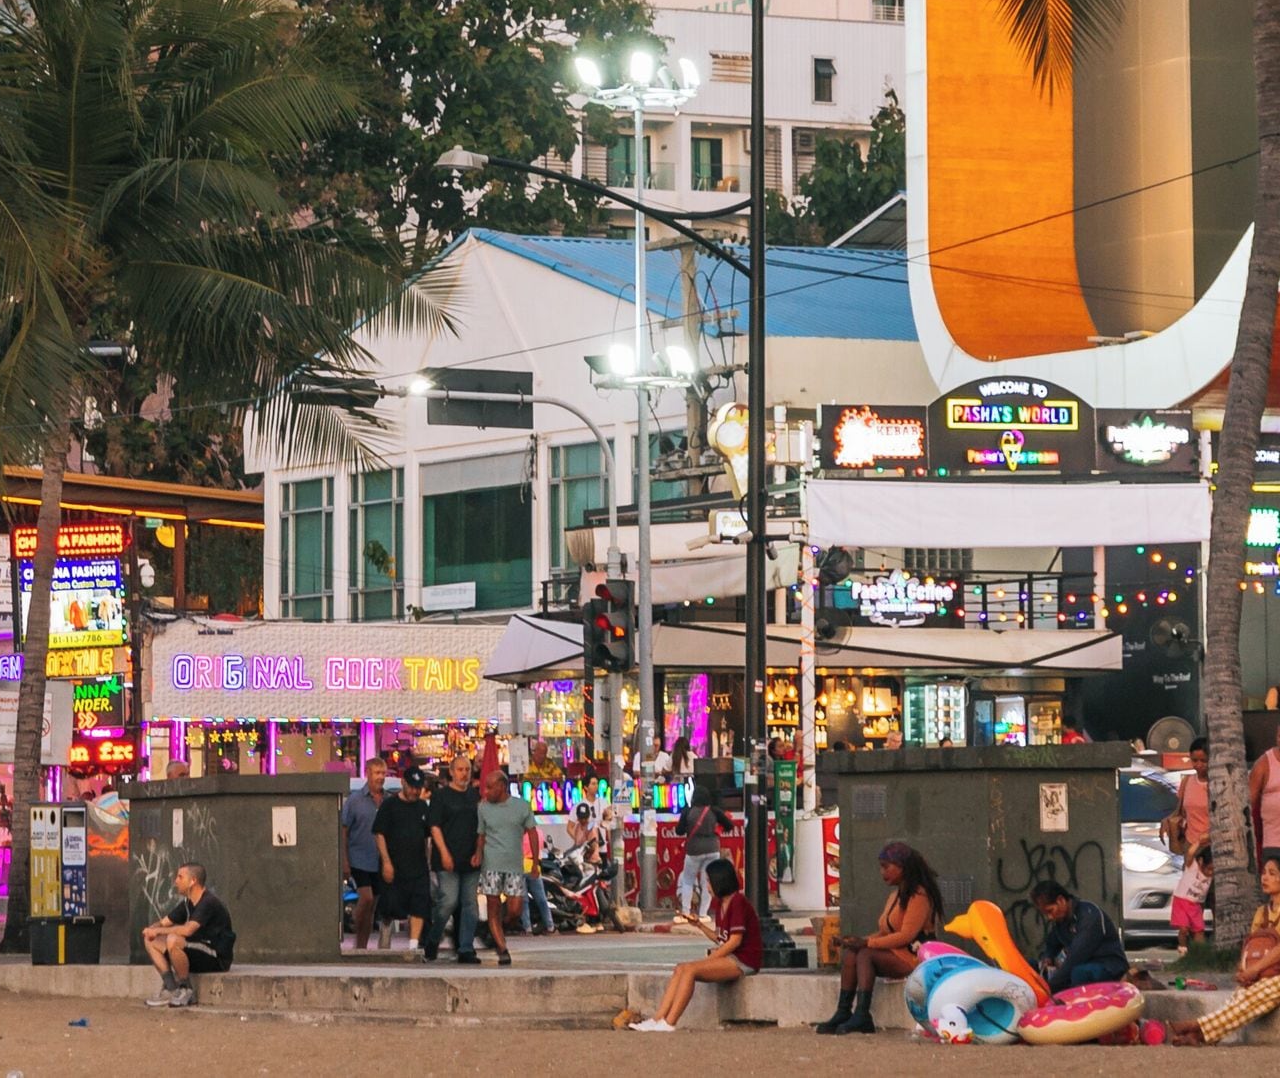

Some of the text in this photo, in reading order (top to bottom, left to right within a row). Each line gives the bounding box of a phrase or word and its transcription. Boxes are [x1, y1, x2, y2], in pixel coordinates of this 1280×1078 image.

[979, 381, 1048, 398] WELCOME TO
[953, 405, 1070, 424] PASHA'S WORLD
[876, 425, 919, 436] KEBAB
[72, 533, 121, 547] FASHION
[71, 564, 117, 580] FASHION
[852, 581, 954, 601] Pasha's Coffee
[53, 634, 102, 644] 81-113-7786
[46, 648, 114, 678] OCKTAILS
[173, 654, 481, 692] ORIGINAL COCKTAILS
